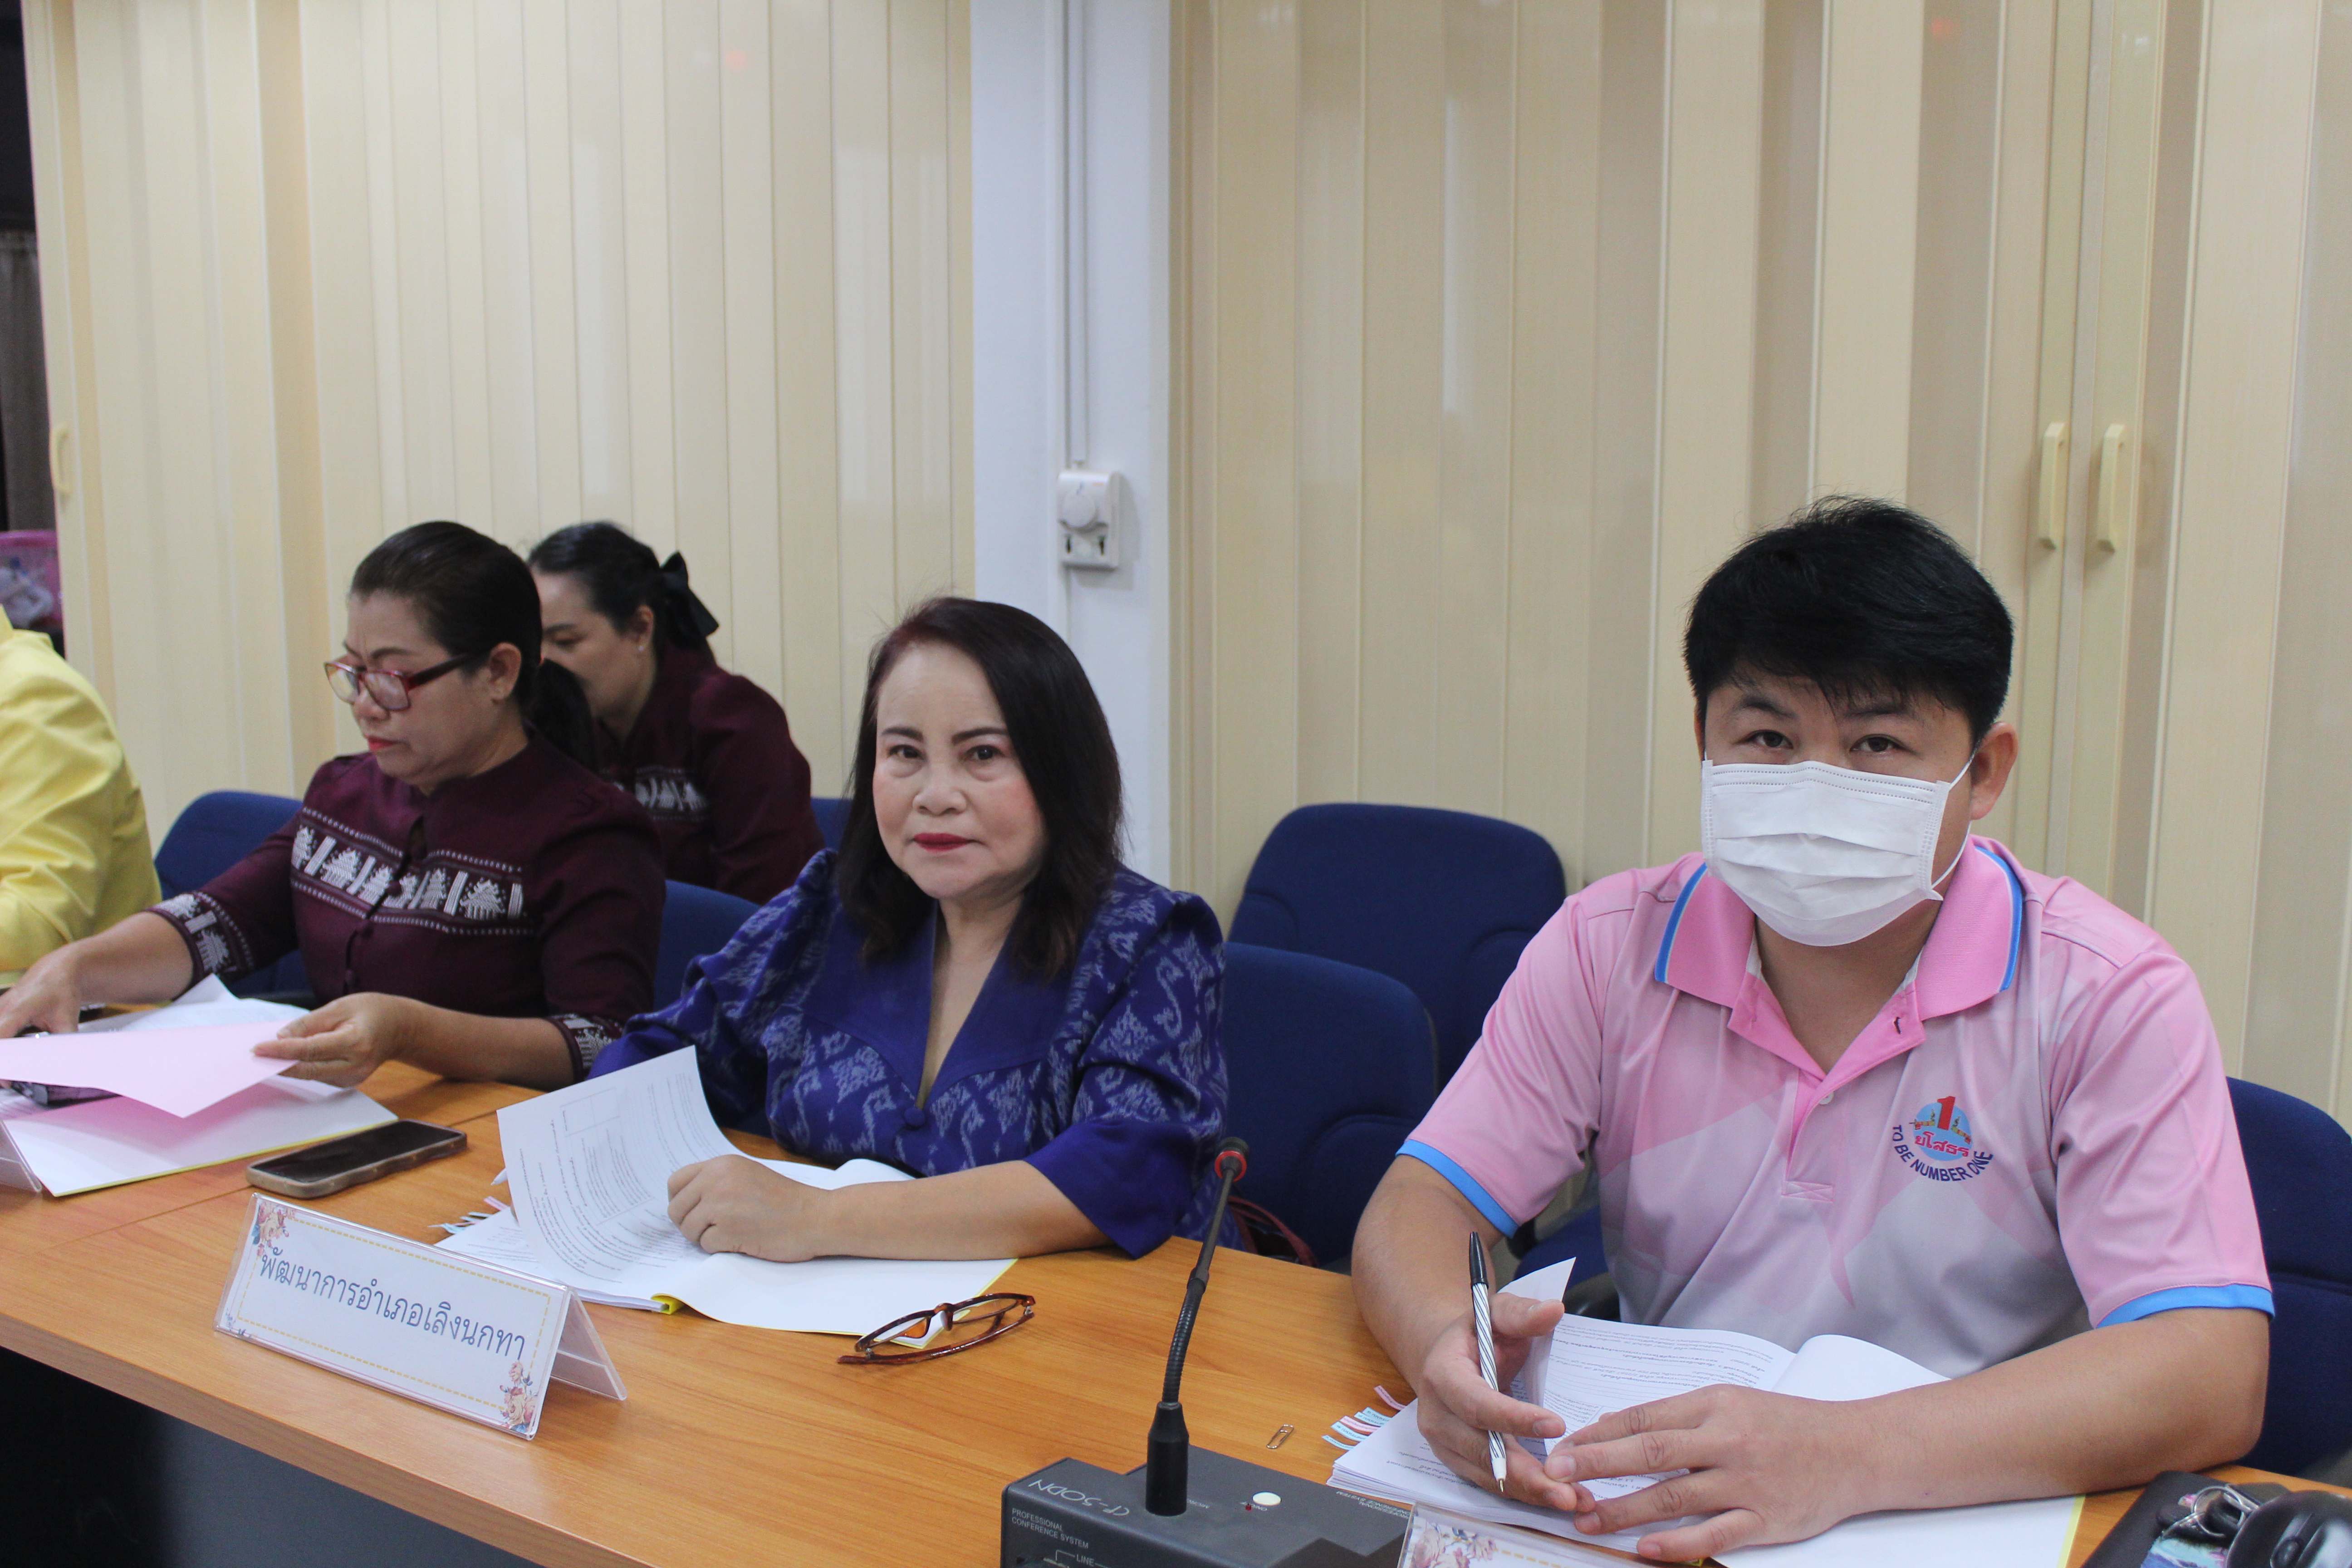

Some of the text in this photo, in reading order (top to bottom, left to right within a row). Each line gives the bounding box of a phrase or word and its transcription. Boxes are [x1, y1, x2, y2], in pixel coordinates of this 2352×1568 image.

[1937, 1096, 1956, 1131] 1
[1892, 1124, 1994, 1181] TO BE NUMBER ONE
[1914, 1131, 1970, 1157] ยโสธร
[260, 1247, 525, 1361] พัฒนาการอำเภอเลิงนกทา
[1012, 1508, 1063, 1532] PROFESSIONAL
[1012, 1517, 1089, 1549] CONFERENCE SYSTEM
[1076, 1553, 1094, 1566] LINE
